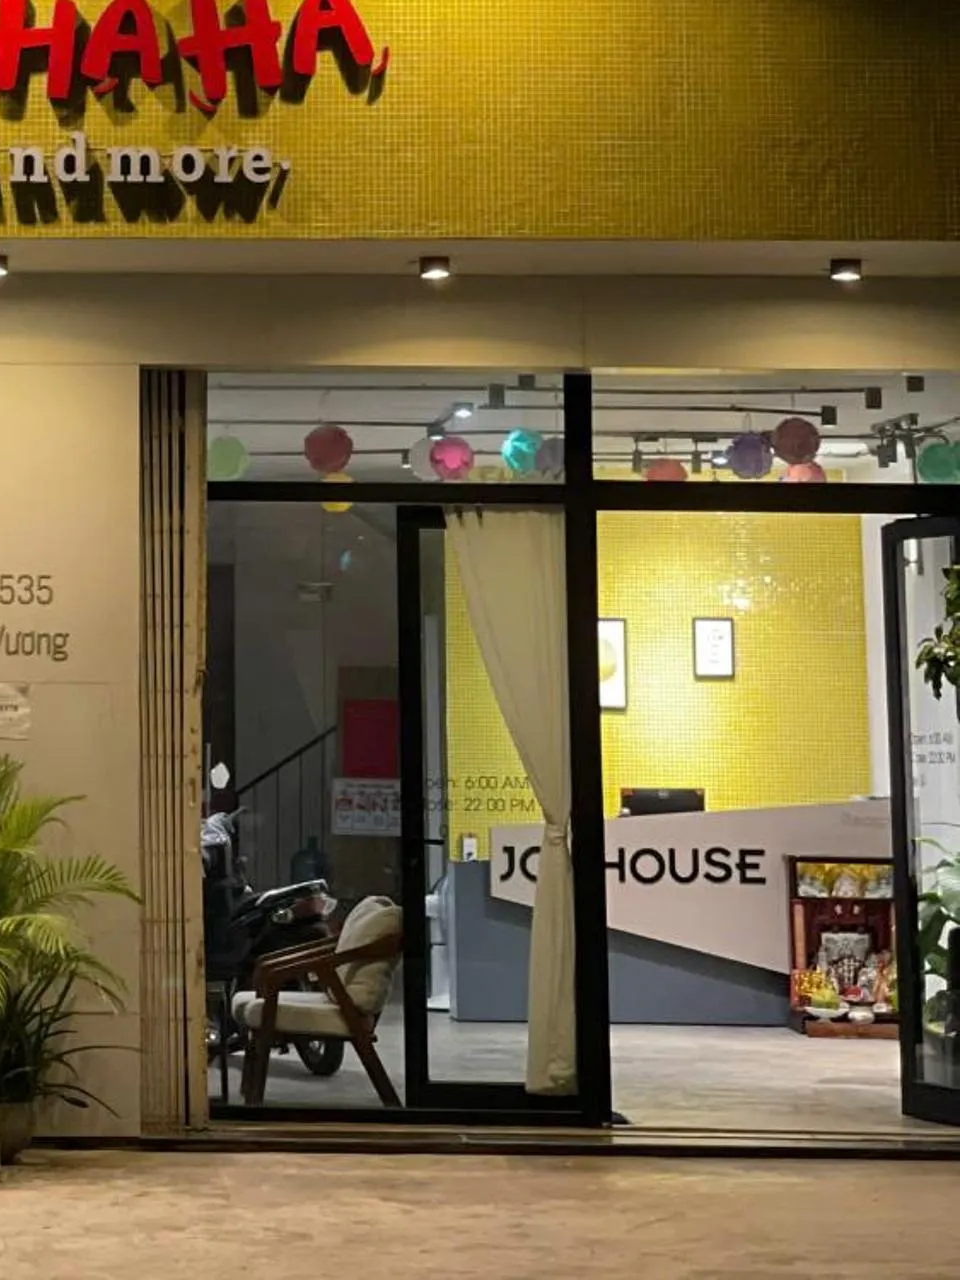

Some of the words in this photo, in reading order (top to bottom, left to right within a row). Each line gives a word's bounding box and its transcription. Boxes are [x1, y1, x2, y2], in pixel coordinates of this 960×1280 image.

[107, 147, 271, 183] more
[510, 798, 536, 812] PM
[499, 845, 543, 883] JO
[605, 847, 767, 885] HOUSE
